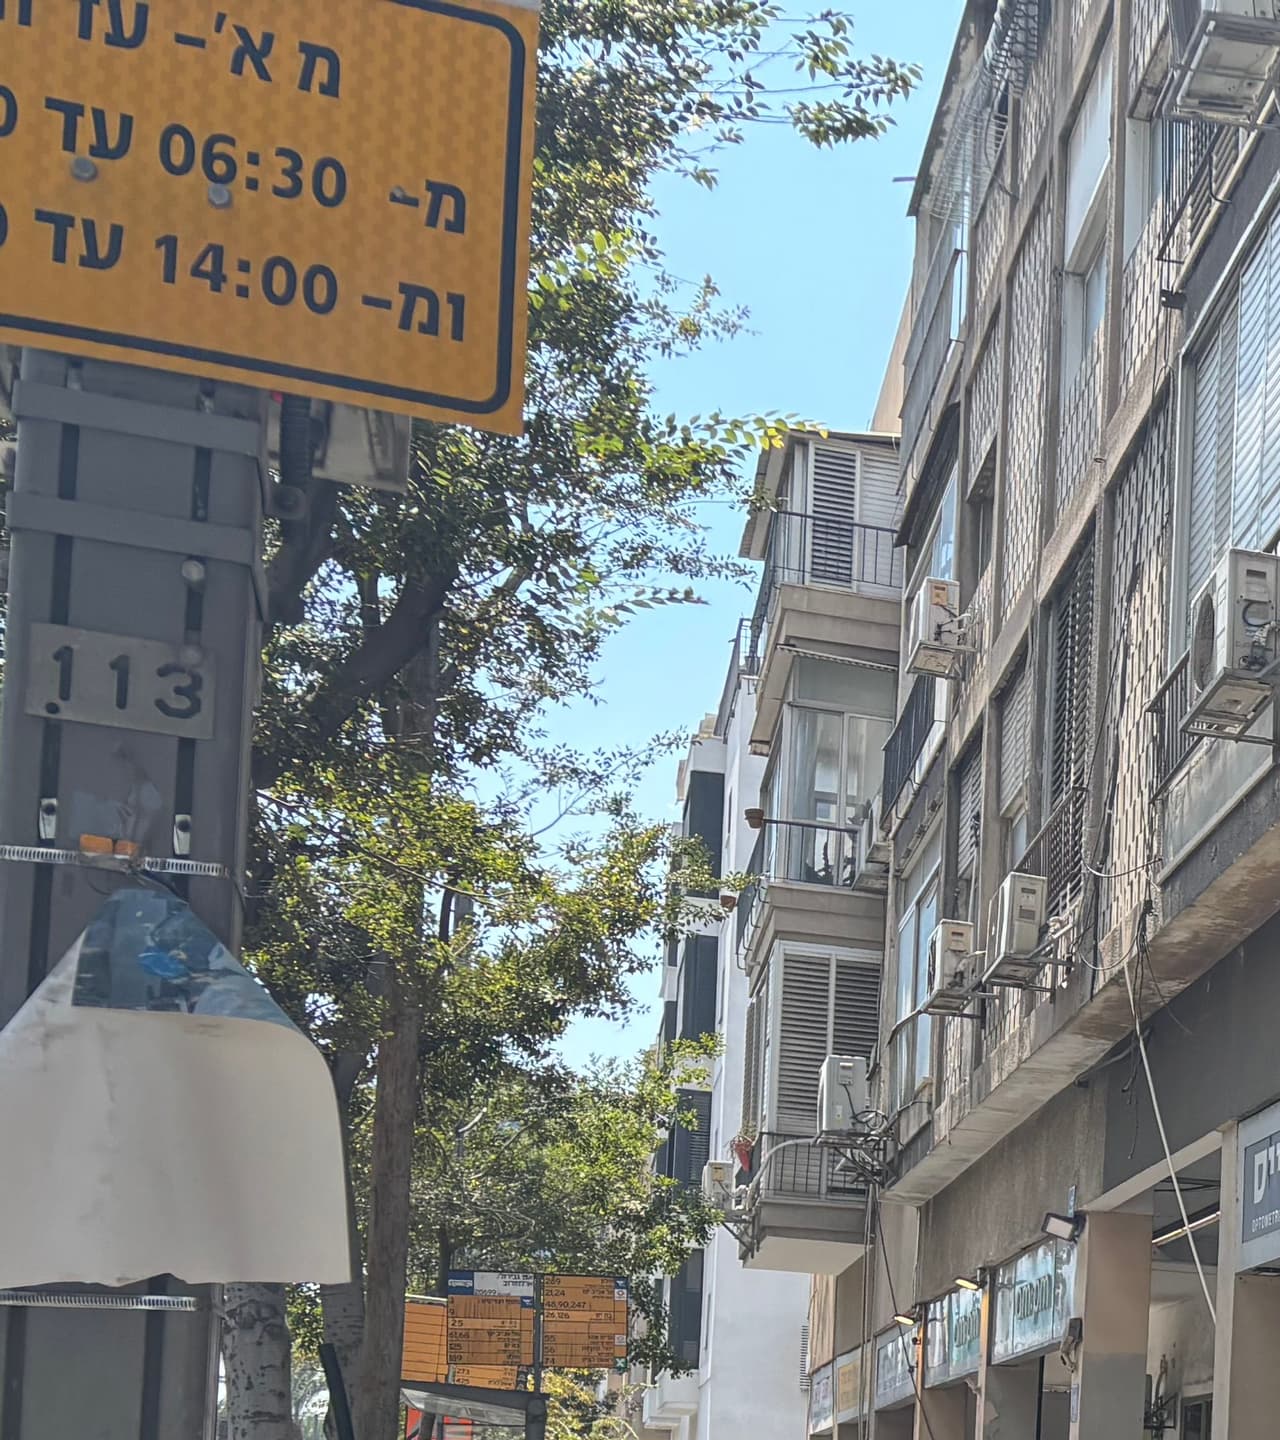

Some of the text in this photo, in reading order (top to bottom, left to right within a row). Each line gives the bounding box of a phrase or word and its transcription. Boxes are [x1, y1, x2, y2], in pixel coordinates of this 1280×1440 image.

[44, 96, 134, 161] עד
[159, 123, 348, 208] 06:30
[34, 208, 124, 270] עד
[154, 234, 338, 316] 14:00
[53, 645, 204, 719] 113
